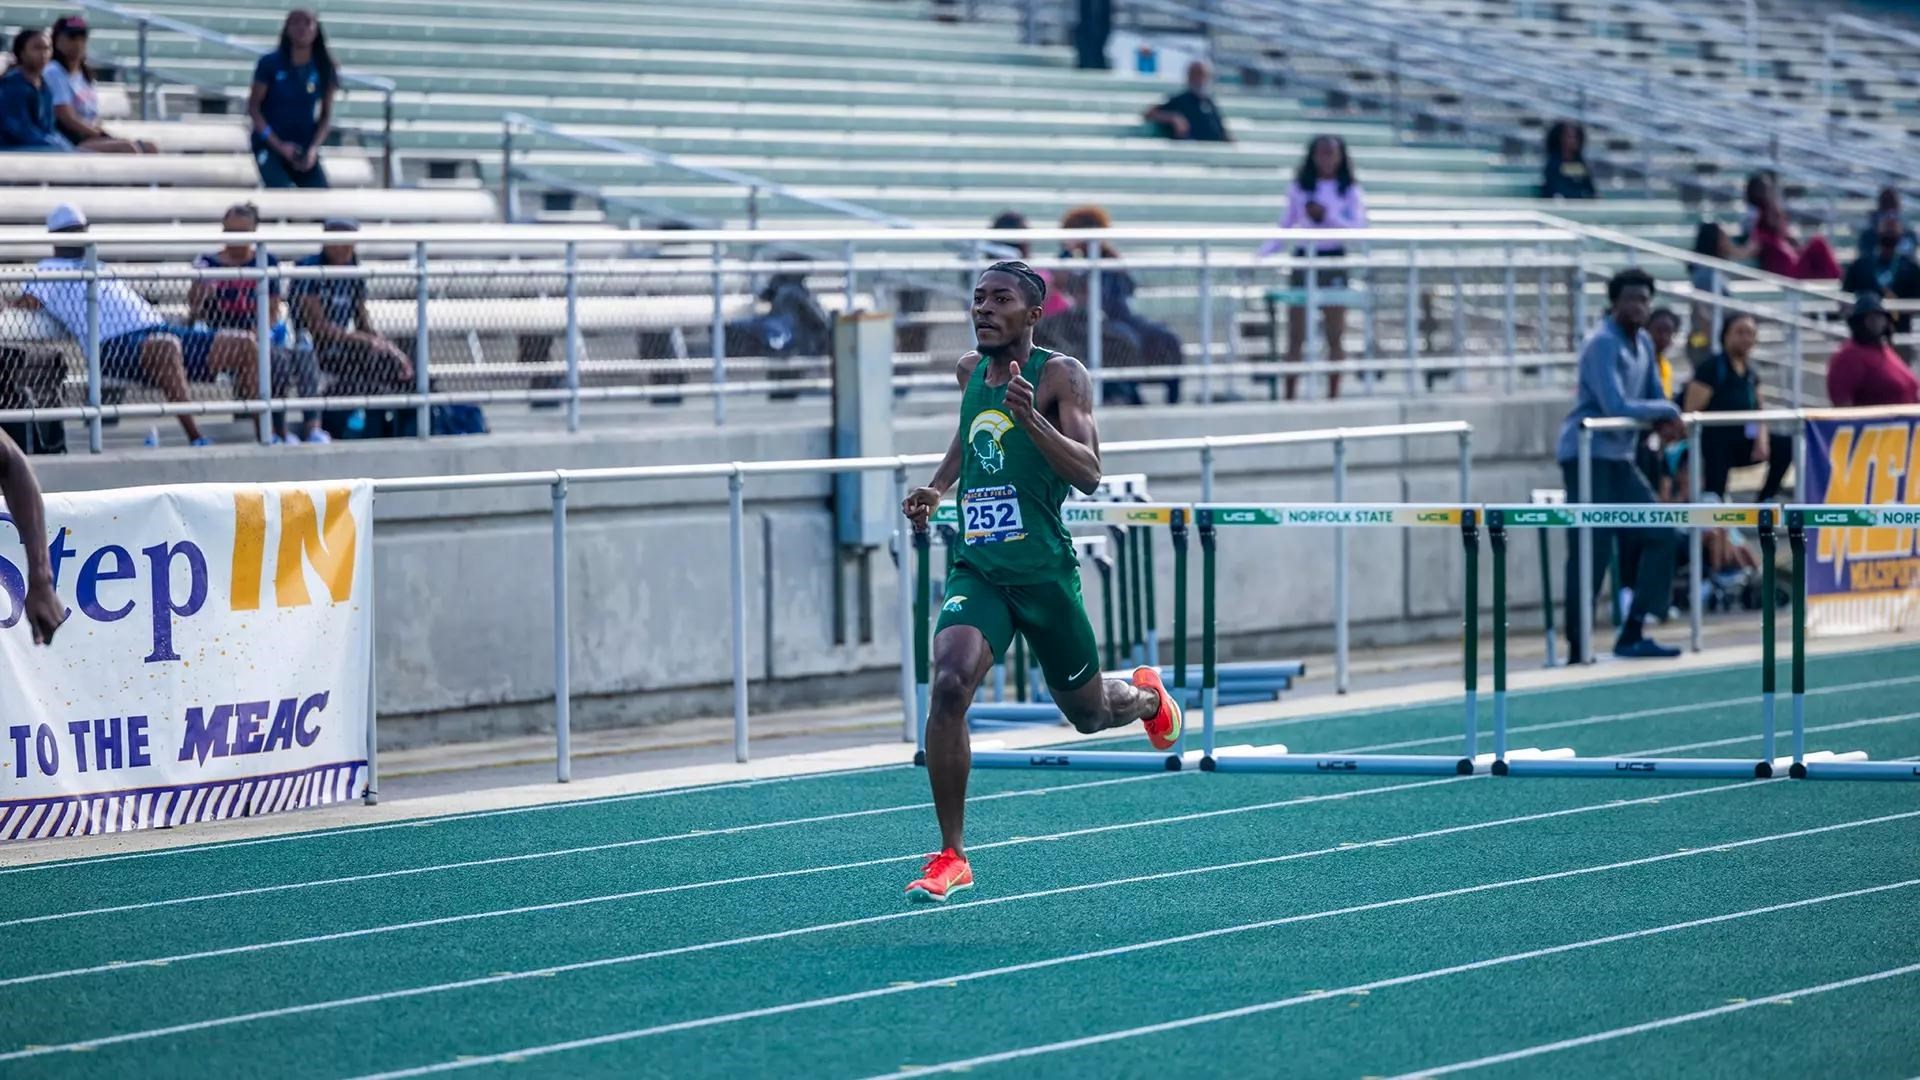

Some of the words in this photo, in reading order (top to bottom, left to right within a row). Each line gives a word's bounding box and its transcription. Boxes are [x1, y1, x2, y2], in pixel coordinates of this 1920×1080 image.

[937, 510, 957, 519] UC
[966, 503, 1017, 530] 252
[1066, 509, 1103, 521] STATE
[1223, 512, 1255, 521] UCS
[1289, 511, 1351, 522] NORFOLK
[1355, 511, 1393, 522] STATE
[1417, 513, 1448, 521] UCS
[1514, 513, 1547, 522] UCS
[1582, 511, 1645, 523] NORFOLK
[1650, 511, 1688, 523] STATE
[1713, 512, 1746, 522] UCS
[1815, 513, 1848, 522] UCS
[230, 488, 356, 611] IN
[10, 723, 59, 778] TO
[69, 715, 151, 773] THE
[178, 690, 329, 767] MEAC
[1030, 755, 1070, 766] UCS
[1317, 760, 1357, 770] UCS
[1616, 761, 1656, 771] UCS
